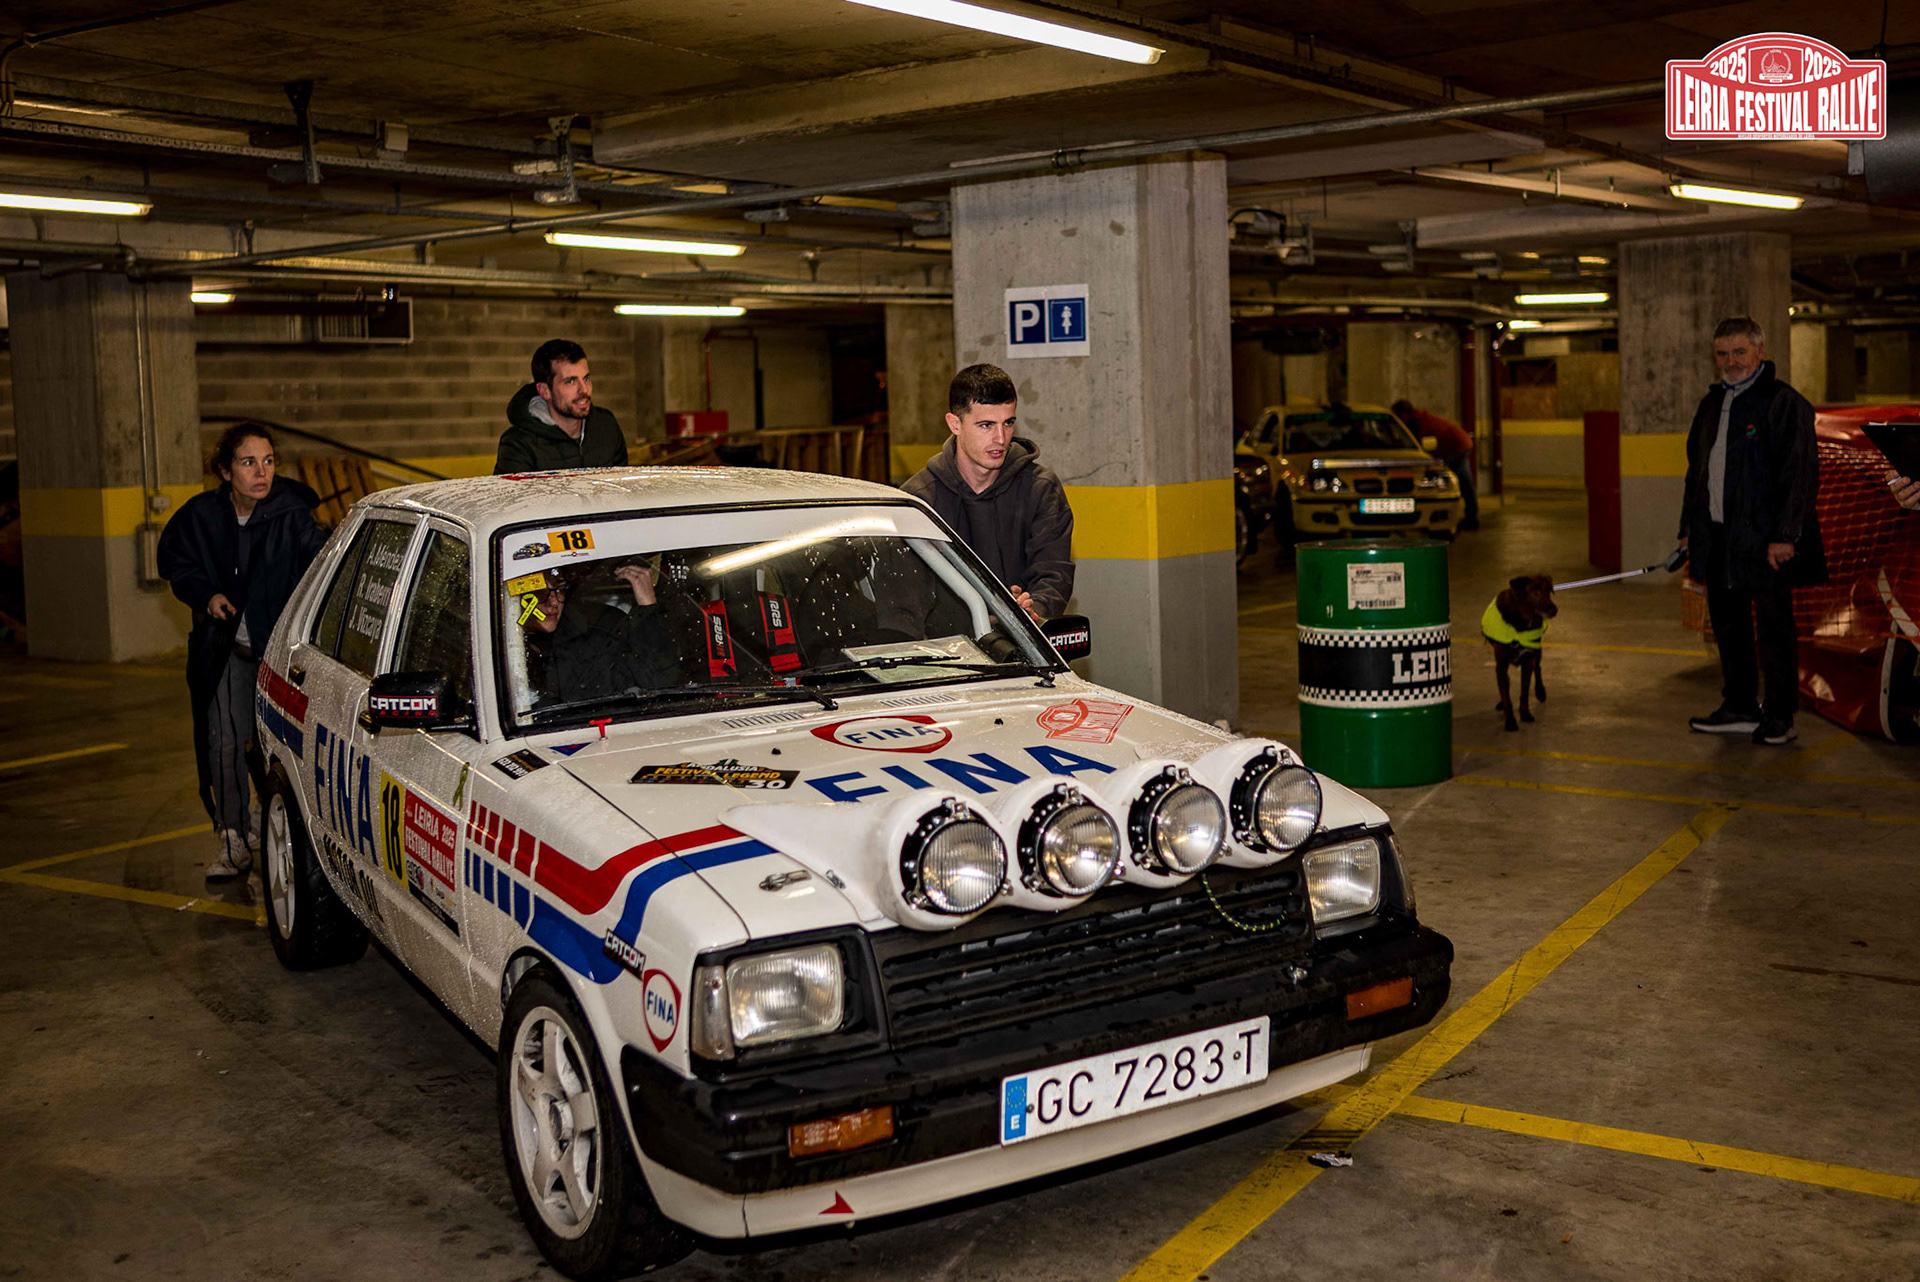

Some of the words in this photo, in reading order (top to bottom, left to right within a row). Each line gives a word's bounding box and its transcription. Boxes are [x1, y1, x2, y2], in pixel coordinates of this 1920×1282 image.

[1015, 303, 1041, 342] P
[556, 530, 588, 551] 18
[1049, 631, 1088, 647] CATCOM
[370, 696, 437, 711] CATCOM
[844, 725, 941, 744] FINA
[745, 780, 786, 789] 30
[804, 745, 1118, 804] FINA
[315, 722, 379, 868] FINA
[382, 781, 403, 881] 18
[414, 802, 440, 841] LEIRIA
[605, 929, 646, 972] CATCOM
[646, 989, 675, 1026] FINA
[1037, 1071, 1095, 1126] GC
[1113, 1039, 1225, 1110] 7283
[1238, 1027, 1262, 1076] T
[1010, 1114, 1021, 1131] E
